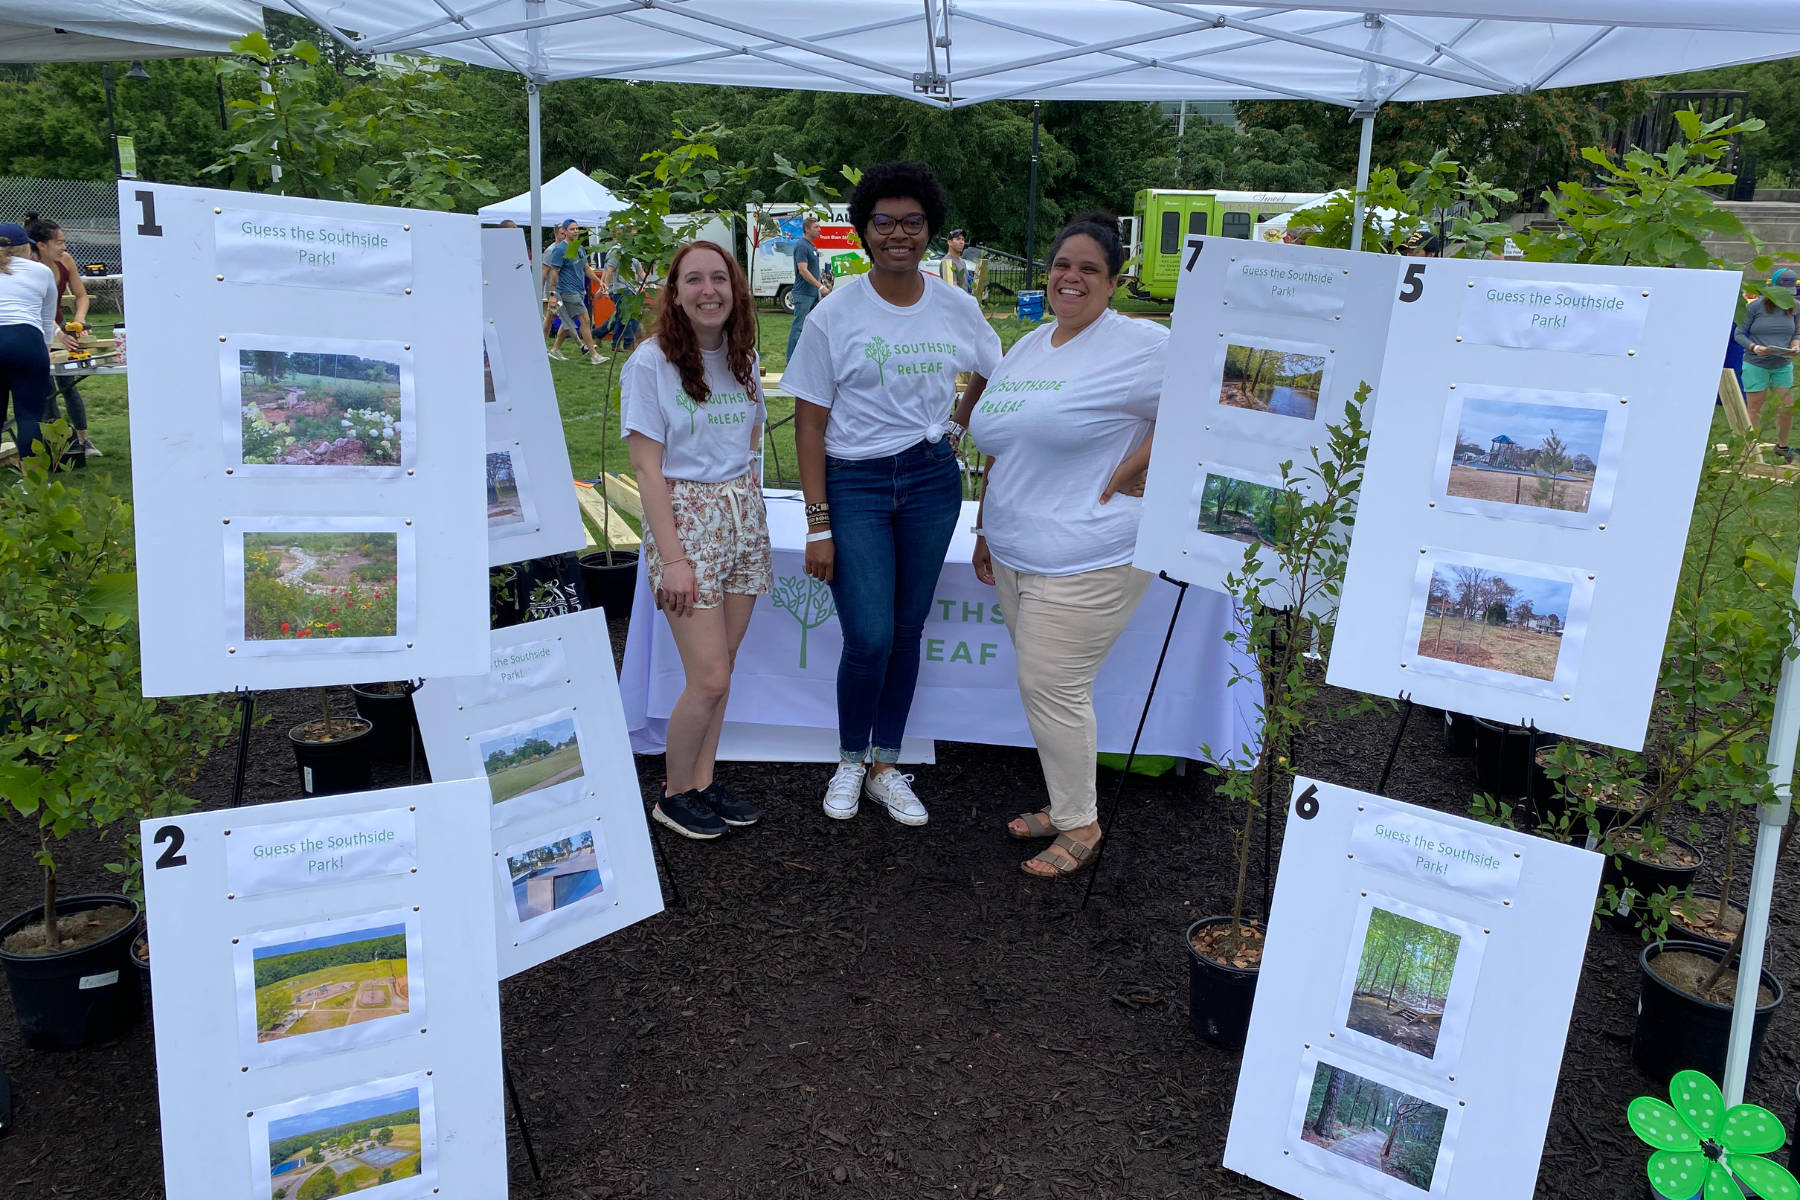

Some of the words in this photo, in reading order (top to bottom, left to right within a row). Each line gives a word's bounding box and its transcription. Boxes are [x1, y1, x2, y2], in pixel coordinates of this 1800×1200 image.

[1253, 193, 1287, 203] Sweet
[134, 190, 163, 237] 1
[242, 221, 286, 238] Guess
[290, 225, 314, 241] the
[319, 228, 388, 248] Southside
[299, 249, 336, 266] Park!
[1186, 240, 1204, 273] 7
[1242, 264, 1268, 277] Guess
[1271, 268, 1285, 279] the
[1287, 270, 1332, 284] Southside
[1398, 263, 1427, 303] 5
[1271, 285, 1296, 297] Park!
[1486, 288, 1525, 303] Guess
[1529, 291, 1551, 305] the
[1555, 293, 1625, 311] Southside
[1531, 313, 1567, 328] Park!
[894, 342, 957, 356] SOUTHSIDE
[897, 362, 943, 375] ReLEAF
[999, 380, 1066, 392] SOUTHSIDE
[979, 399, 1026, 413] ReLEAF
[708, 411, 746, 424] ReLEAF
[493, 657, 509, 668] the
[510, 648, 551, 664] Southside
[501, 668, 523, 681] Park!
[1295, 783, 1320, 821] 6
[153, 824, 187, 870] 2
[253, 842, 296, 857] Guess
[300, 838, 323, 852] the
[328, 829, 394, 848] Southside
[1375, 824, 1411, 844] Guess
[1414, 836, 1435, 850] the
[1438, 842, 1500, 869] Southside
[308, 856, 344, 873] Park!
[1416, 856, 1449, 875] Park!
